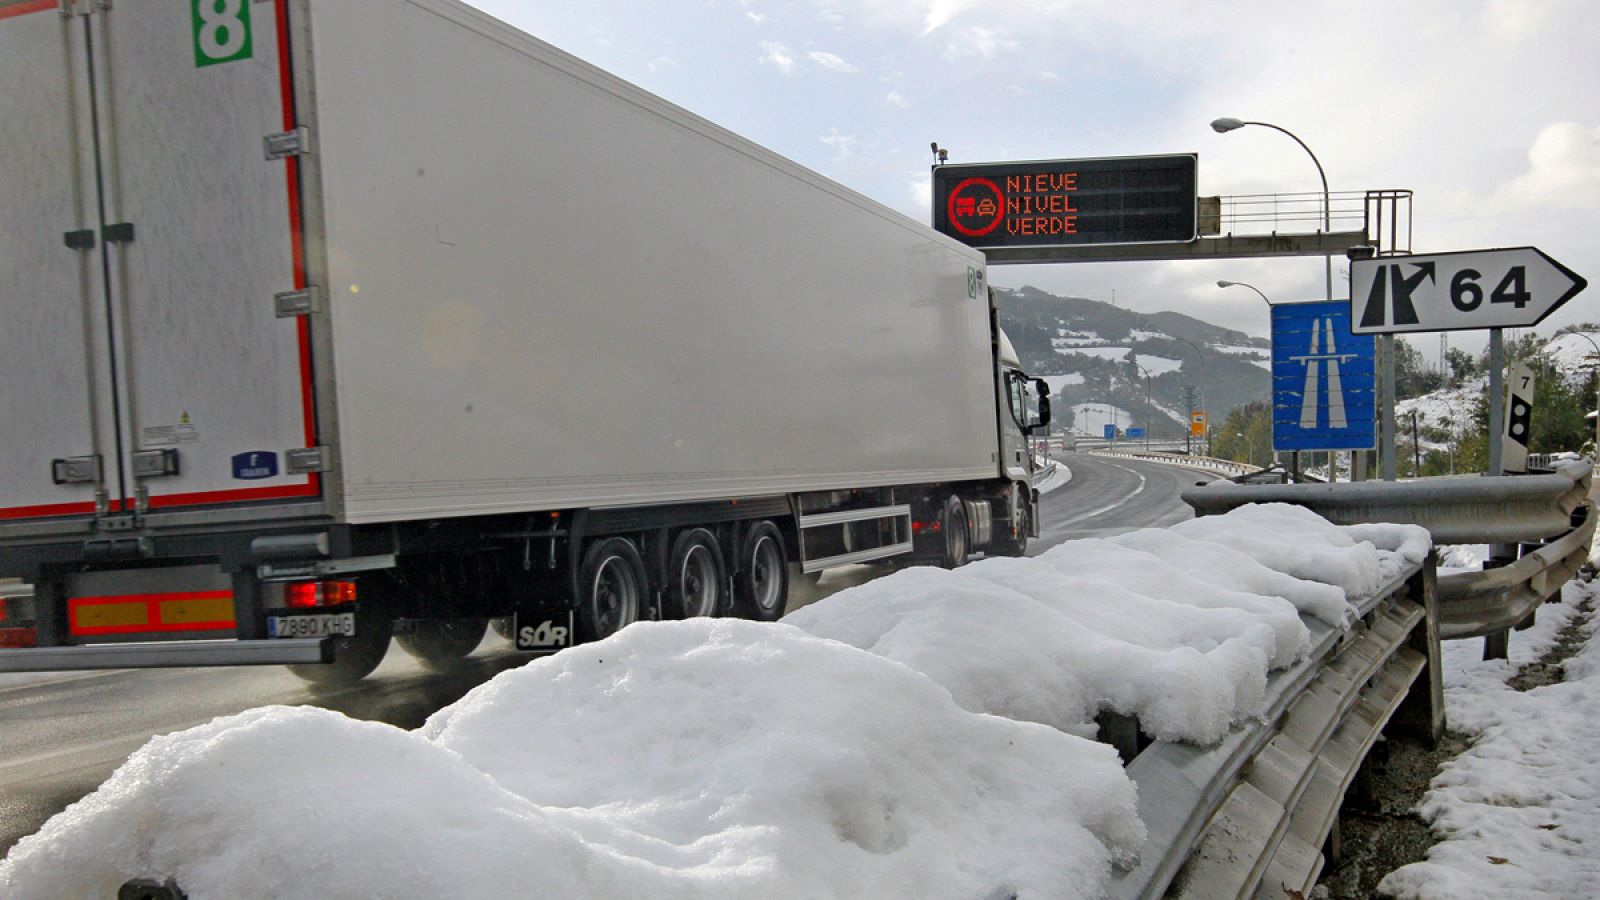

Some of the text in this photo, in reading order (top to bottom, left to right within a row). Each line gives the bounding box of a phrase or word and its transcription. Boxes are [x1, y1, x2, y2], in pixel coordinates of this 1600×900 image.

[197, 0, 246, 59] 8
[1007, 172, 1077, 193] NIEVE
[1007, 195, 1077, 214] NIVEL
[1007, 215, 1077, 236] VERDE
[1450, 265, 1532, 313] 64
[1521, 376, 1530, 390] 7
